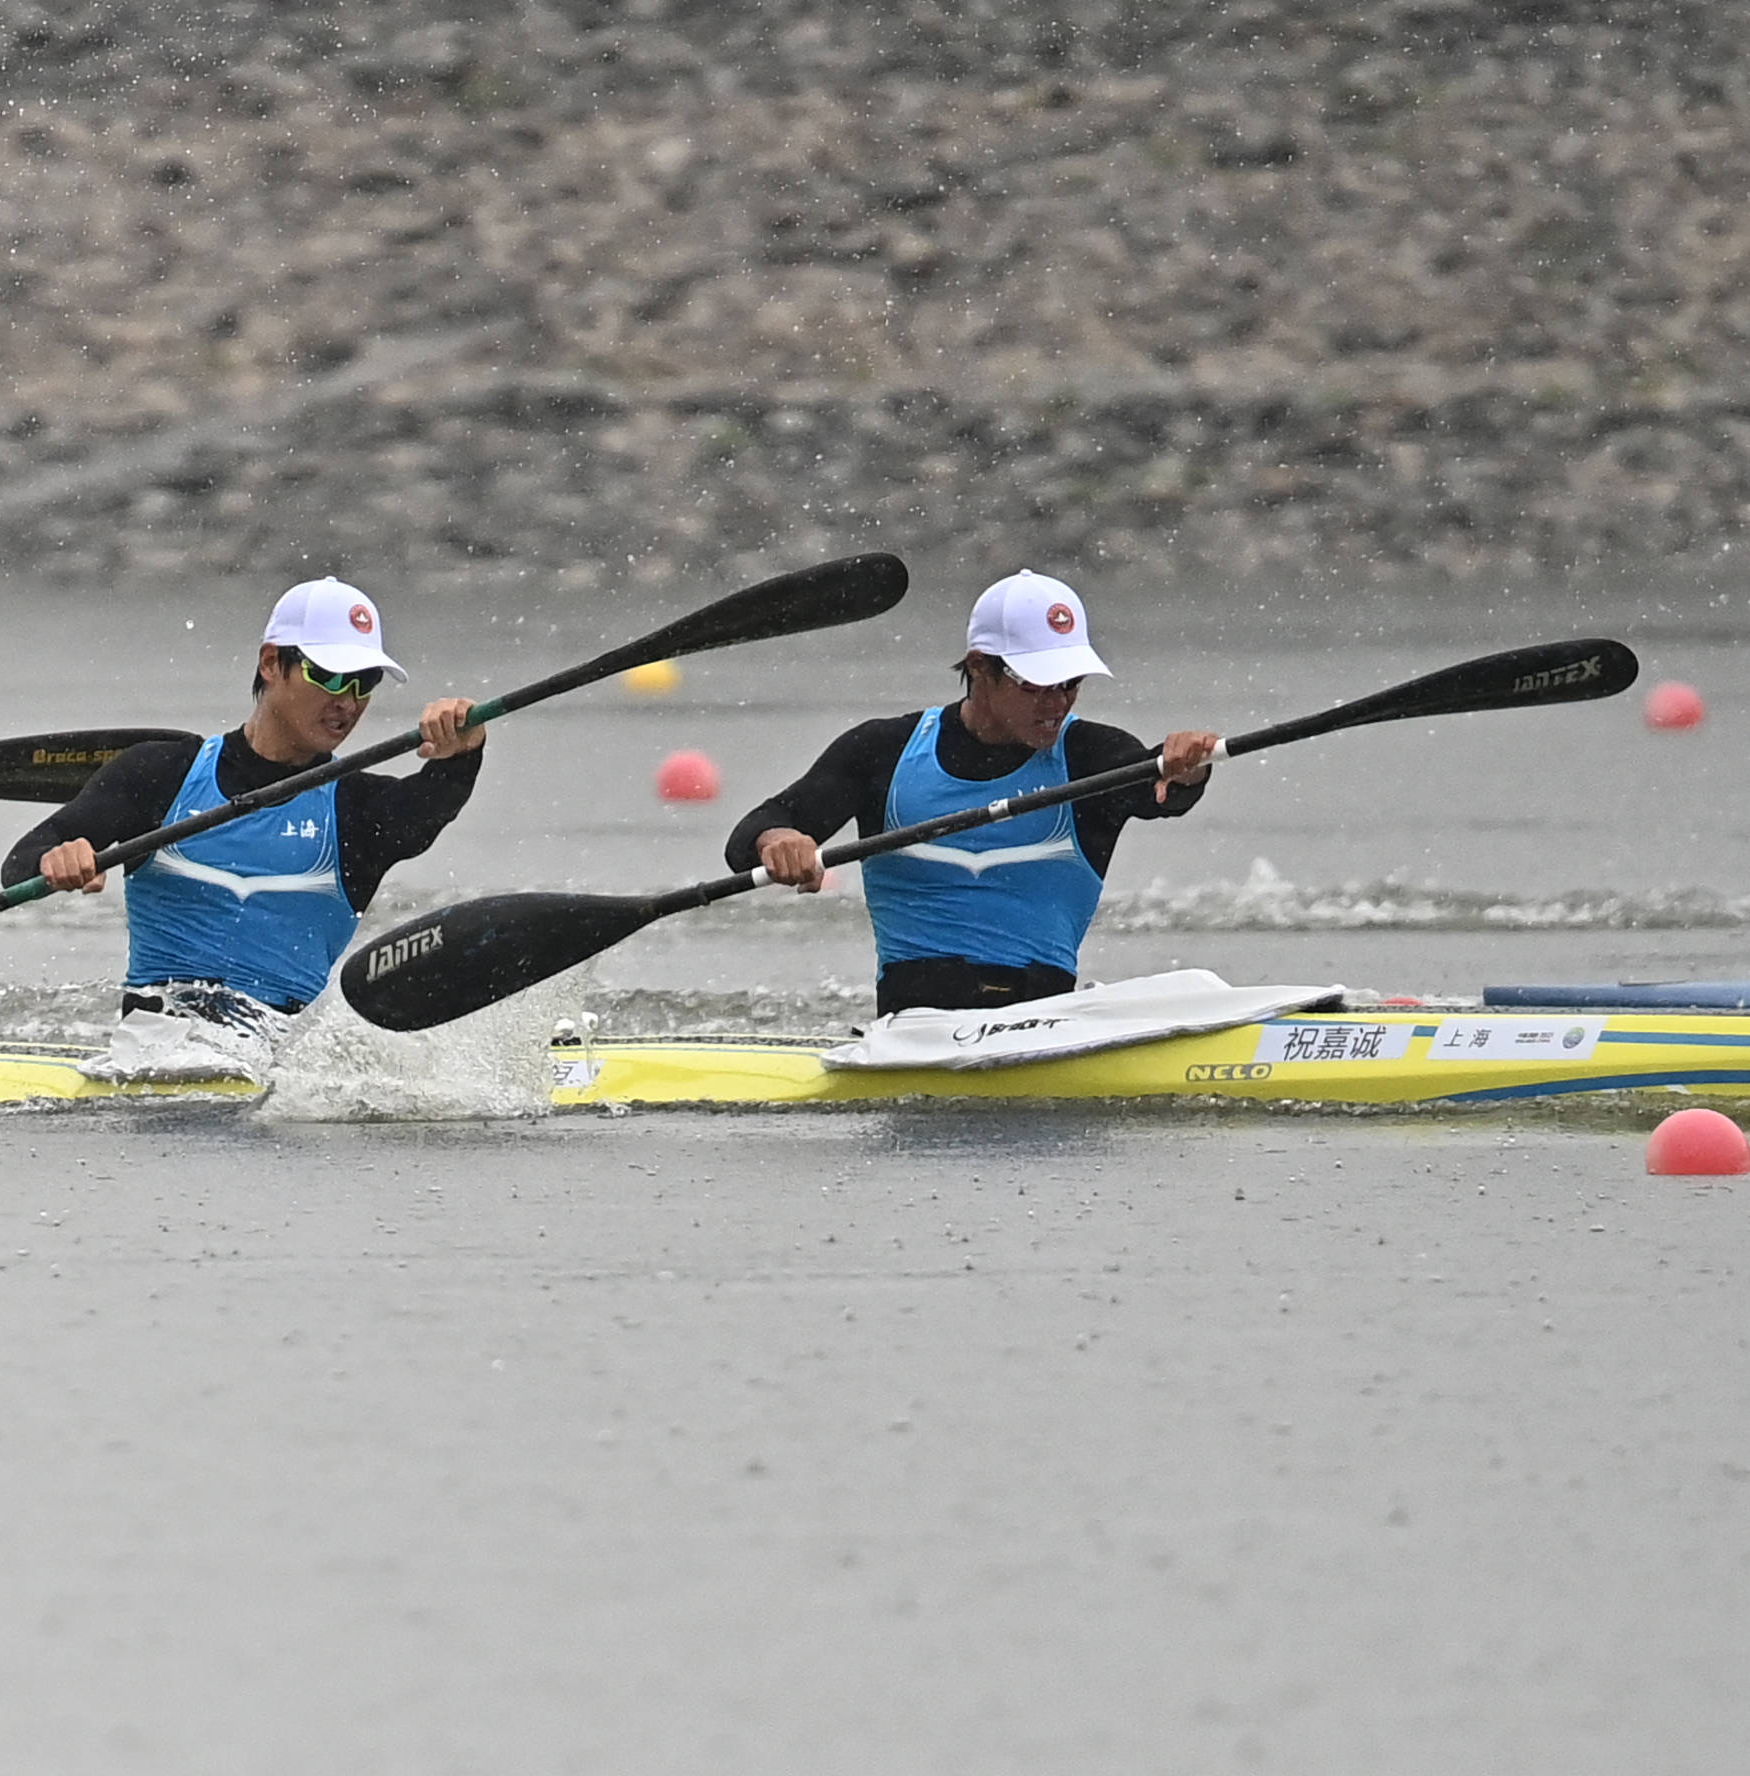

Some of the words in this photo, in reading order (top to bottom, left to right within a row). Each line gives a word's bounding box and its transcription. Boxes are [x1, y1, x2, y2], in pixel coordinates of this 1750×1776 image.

[1283, 1026, 1386, 1061] 祝嘉诚
[1443, 1028, 1492, 1048] 上海
